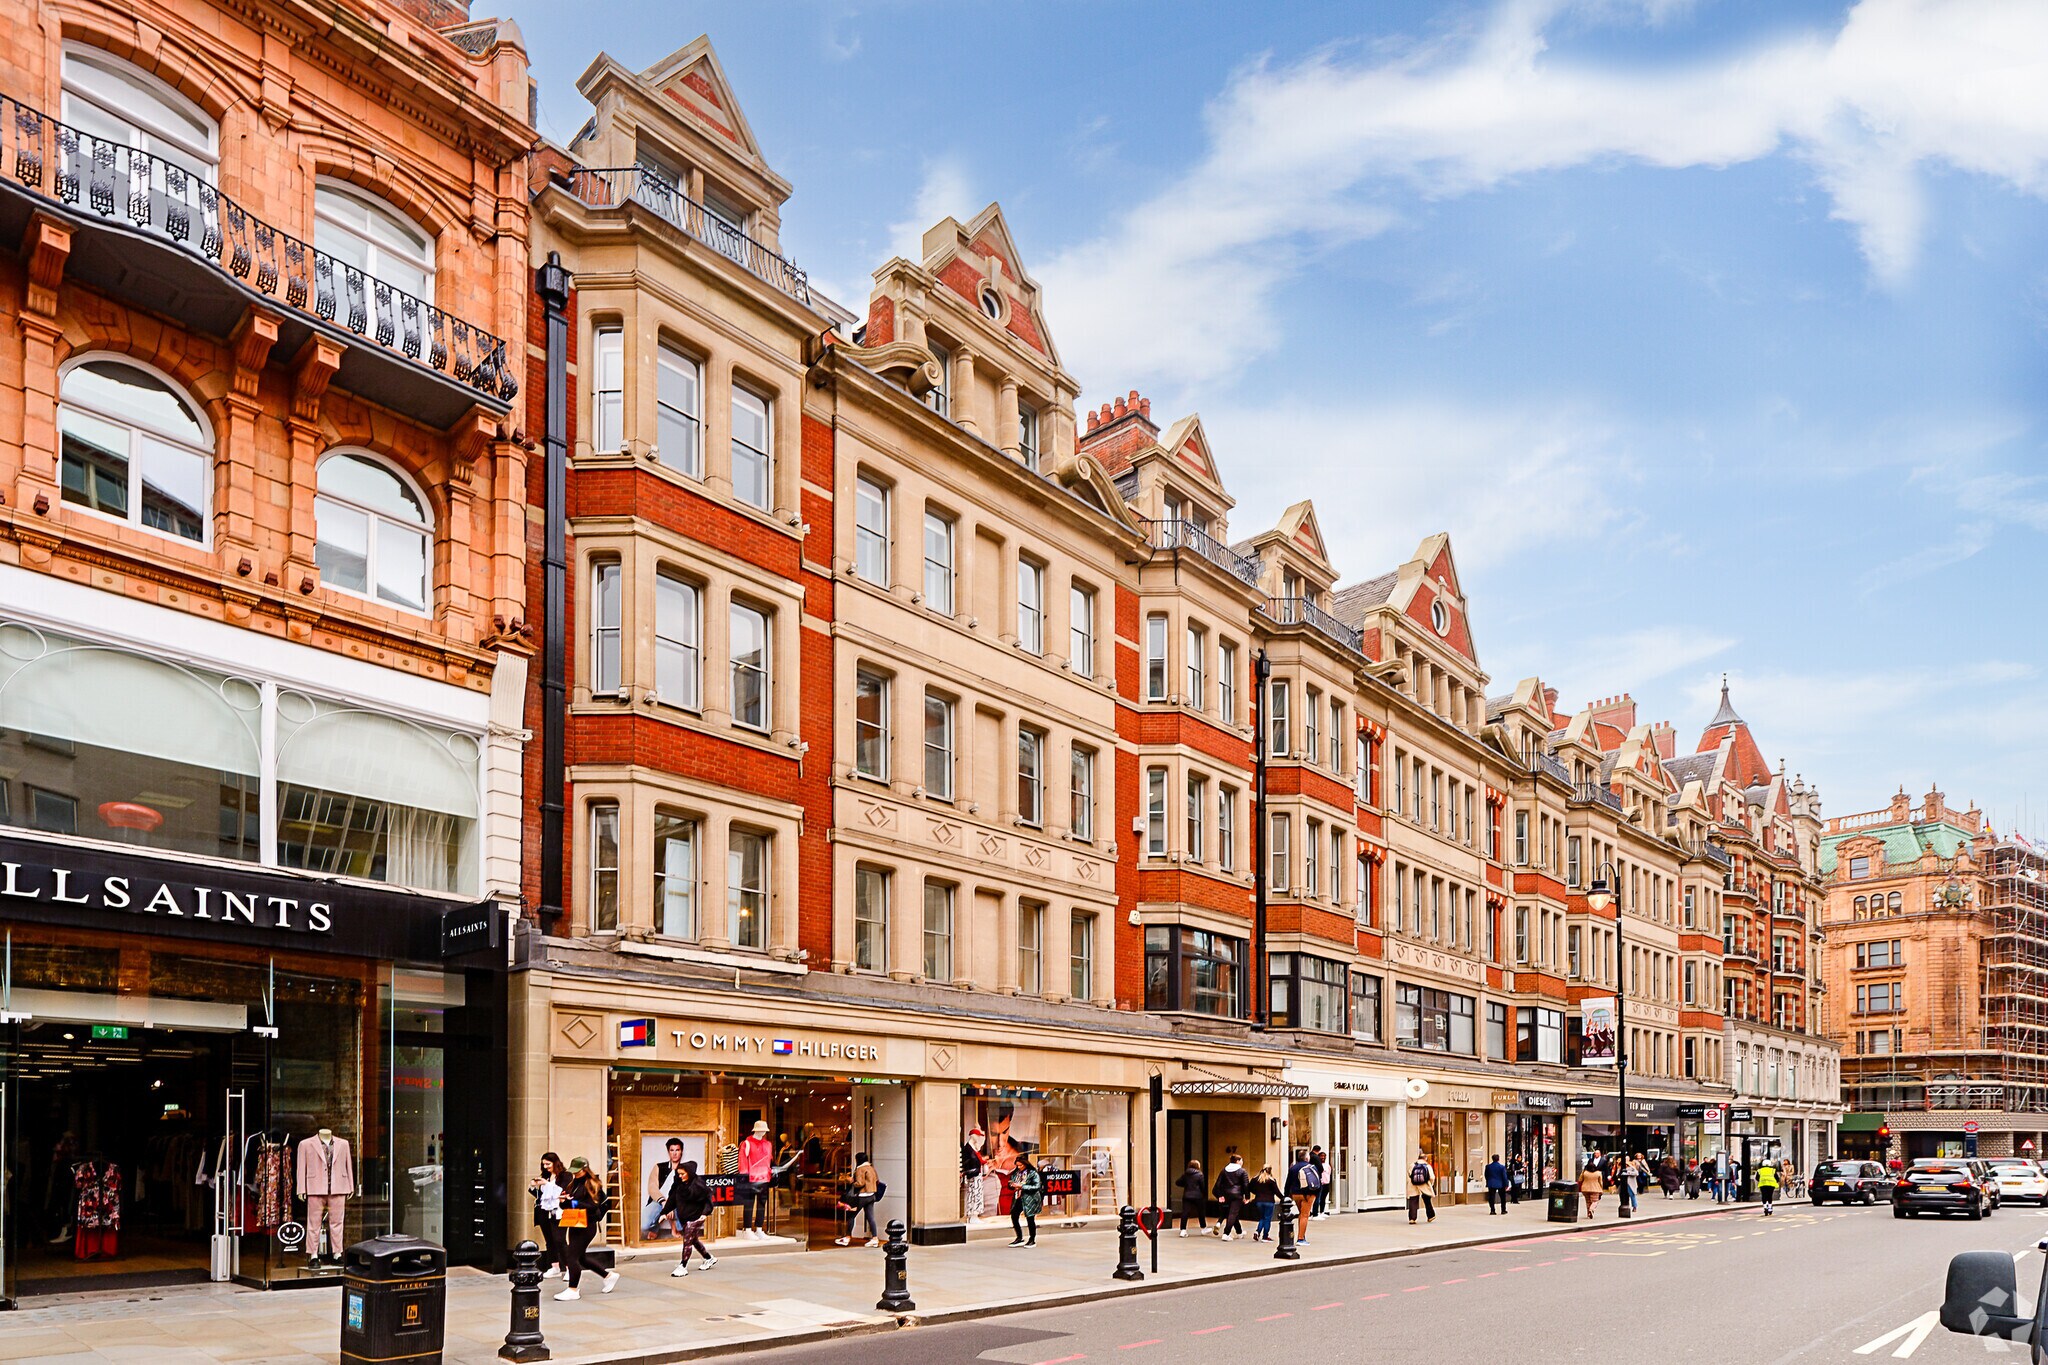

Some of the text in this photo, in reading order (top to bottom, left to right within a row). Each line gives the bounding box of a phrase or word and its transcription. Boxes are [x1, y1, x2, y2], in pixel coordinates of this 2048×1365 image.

[449, 921, 487, 937] ALLSAINTS
[671, 1031, 878, 1060] TOMMY HILFIGER
[1528, 1097, 1551, 1106] DIESEL
[706, 1178, 734, 1187] SEASON
[1047, 1180, 1072, 1192] SALE
